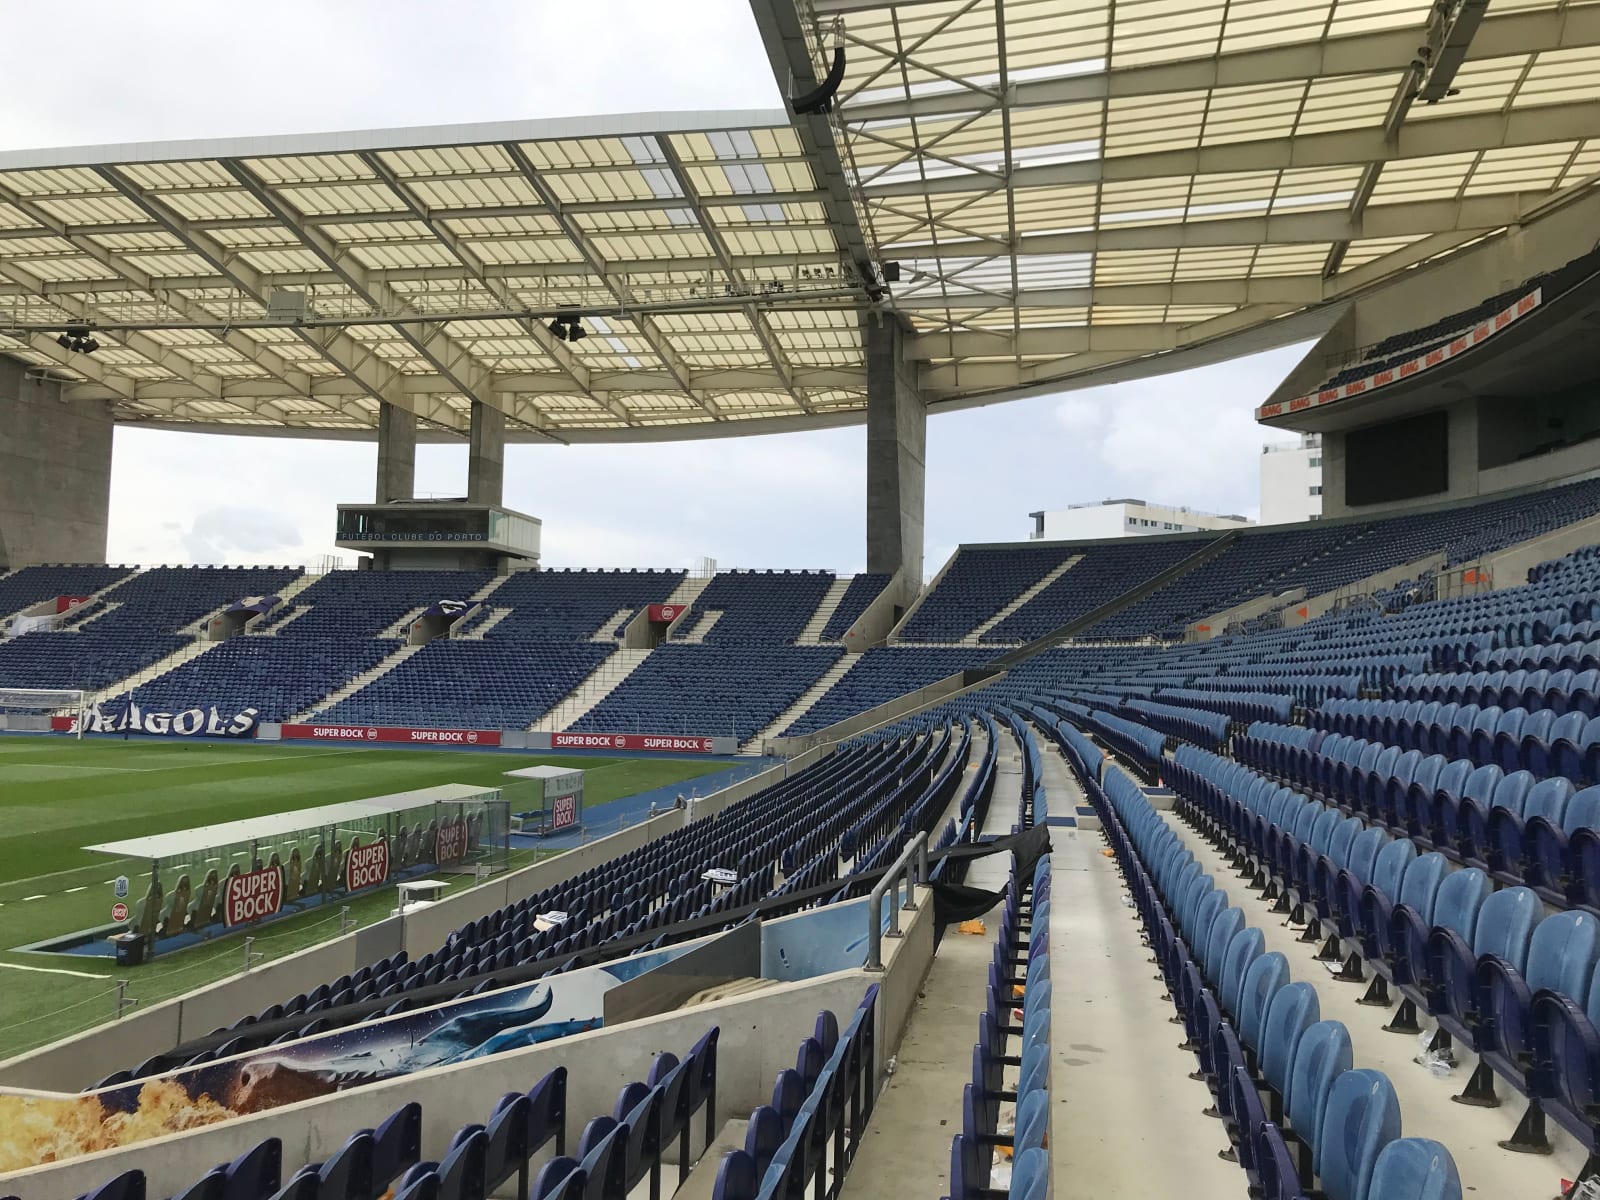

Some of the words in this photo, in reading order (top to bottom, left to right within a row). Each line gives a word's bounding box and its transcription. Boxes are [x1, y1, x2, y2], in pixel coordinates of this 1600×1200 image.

[1261, 405, 1281, 417] BMG
[1290, 397, 1310, 411] BMG
[1318, 389, 1338, 403] BMG
[1346, 381, 1366, 395] BMG
[1373, 370, 1393, 386] BMG
[1400, 360, 1419, 377] BMG
[1426, 349, 1444, 367] BMG
[342, 533, 386, 541] FUTEBOL
[391, 533, 423, 541] CLUBE
[429, 533, 442, 541] DO
[447, 533, 482, 541] PORTO
[313, 728, 339, 737] SUPER
[340, 728, 363, 738] BOCK
[411, 731, 438, 741] SUPER
[439, 732, 463, 742] BOCK
[556, 735, 584, 746] SUPER
[585, 736, 610, 746] BOCK
[644, 738, 672, 748] SUPER
[673, 739, 699, 749] BOCK
[556, 797, 573, 813] SUPER
[556, 810, 572, 826] BOCK
[351, 845, 384, 870] SUPER
[440, 842, 459, 860] BOC
[353, 863, 382, 887] BOCK
[232, 871, 277, 900] SUPER
[234, 891, 274, 921] BOCK
